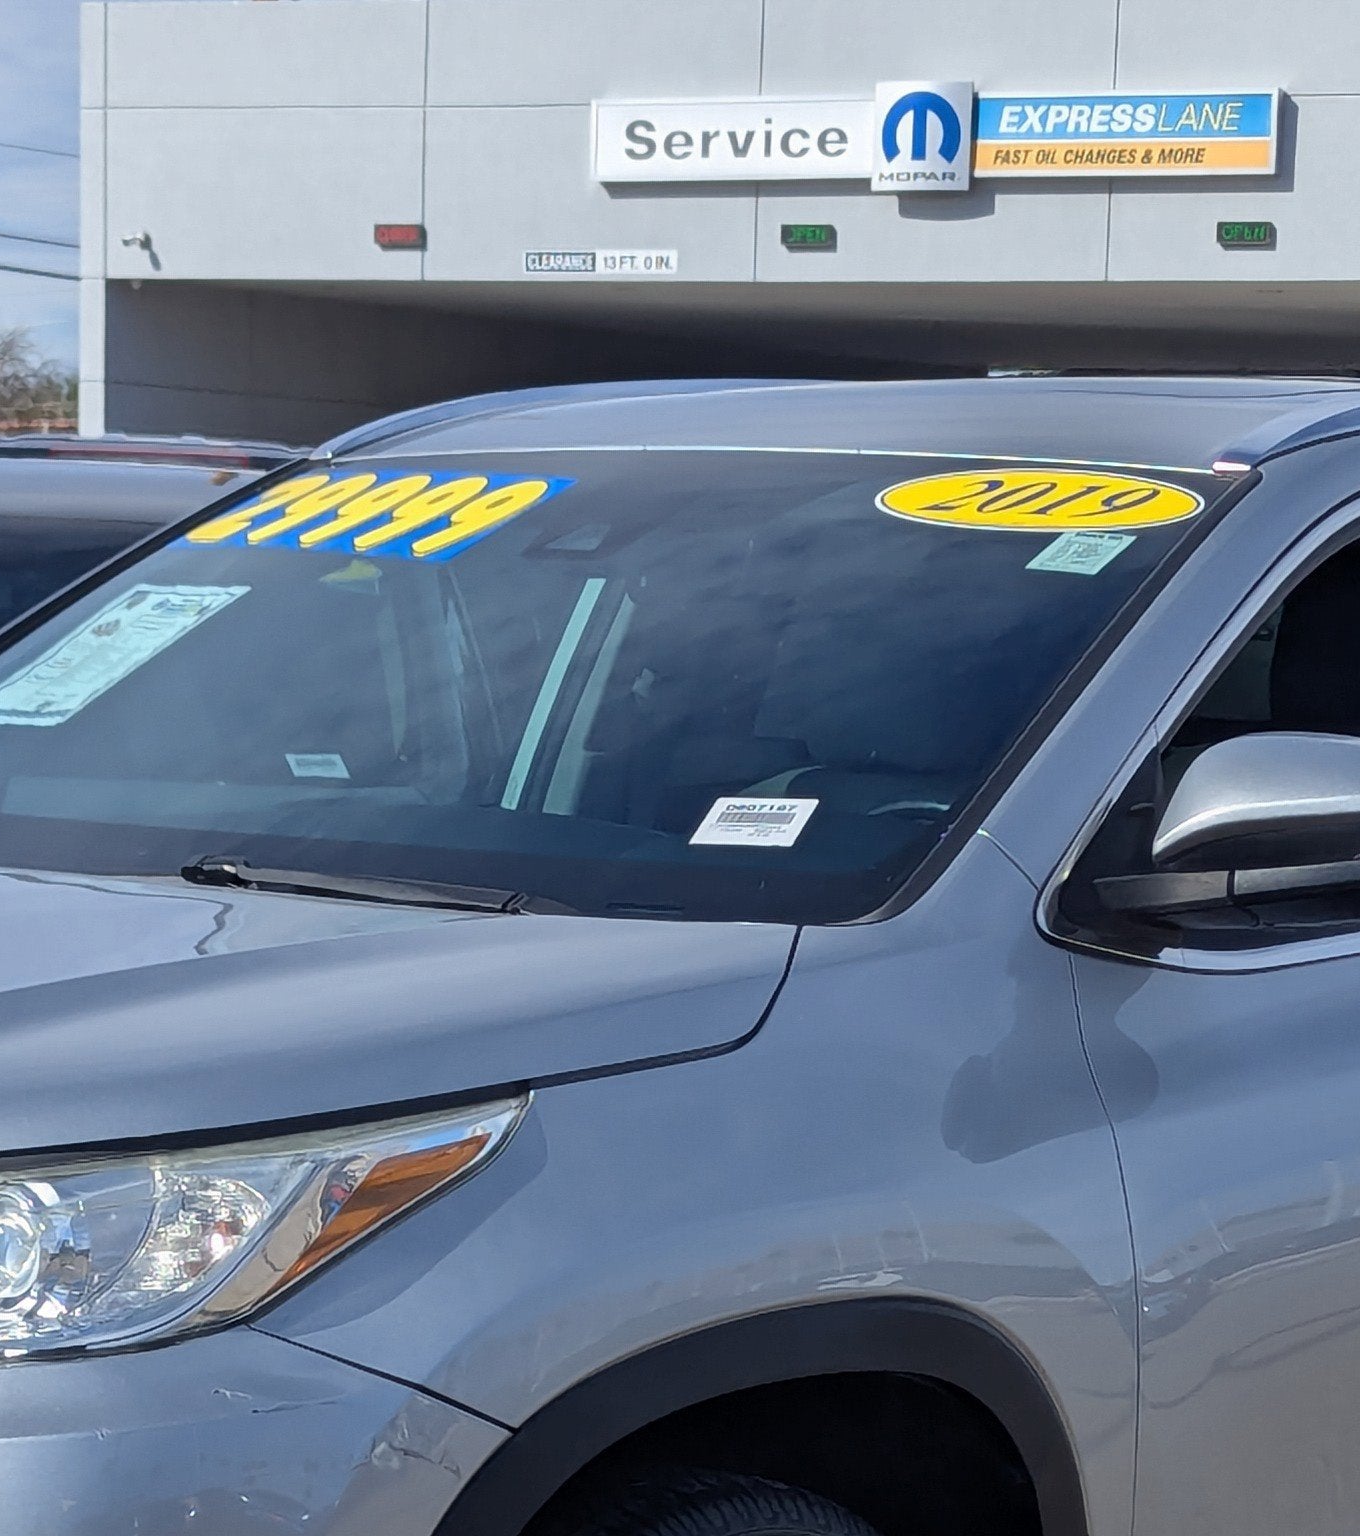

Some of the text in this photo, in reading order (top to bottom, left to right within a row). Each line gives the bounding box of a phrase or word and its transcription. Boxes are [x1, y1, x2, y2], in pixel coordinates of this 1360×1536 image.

[624, 118, 849, 160] Service
[993, 147, 1207, 165] FAST OIL CHANGES & MORE
[878, 172, 958, 182] MOPAR
[185, 473, 549, 558] 29999
[916, 480, 1161, 517] 2019
